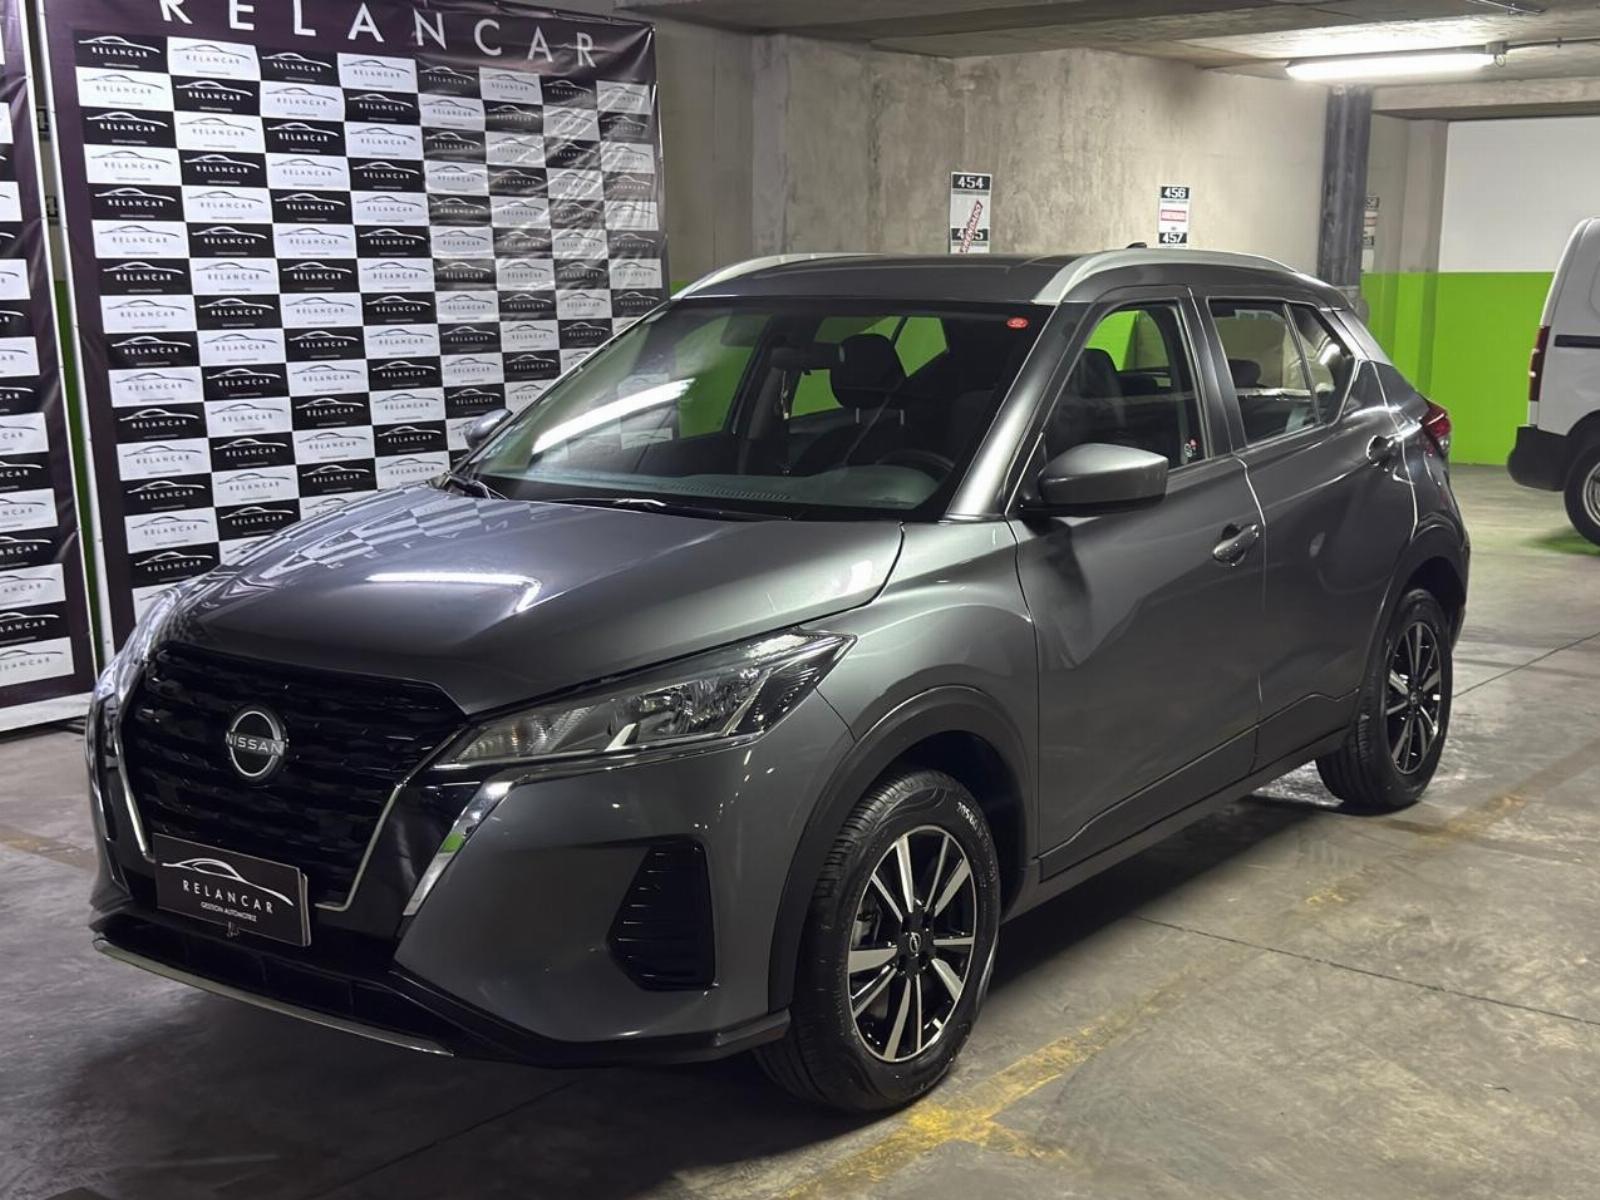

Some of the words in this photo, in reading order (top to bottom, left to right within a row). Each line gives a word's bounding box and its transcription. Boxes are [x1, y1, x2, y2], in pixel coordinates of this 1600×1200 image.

[92, 47, 147, 58] RELANCAR
[186, 54, 240, 65] RELANCAR
[273, 62, 321, 72] RELANCAR
[353, 70, 400, 78] RELANCAR
[96, 85, 152, 95] RELANCAR
[188, 92, 241, 101] RELANCAR
[277, 98, 326, 106] RELANCAR
[100, 123, 155, 132] RELANCAR
[192, 128, 245, 136] RELANCAR
[104, 161, 160, 170] RELANCAR
[196, 165, 248, 174] RELANCAR
[958, 176, 984, 188] 454
[1164, 187, 1186, 198] 456
[108, 199, 163, 207] RELANCAR
[956, 229, 984, 240] 45
[1162, 233, 1183, 243] 457
[128, 382, 182, 391] RELANCAR
[306, 407, 354, 416] RELANCAR
[222, 413, 273, 422] RELANCAR
[131, 418, 186, 428] RELANCAR
[387, 434, 432, 443] RELANCAR
[309, 440, 357, 449] RELANCAR
[226, 447, 276, 456] RELANCAR
[136, 454, 190, 464] RELANCAR
[390, 466, 435, 475] RELANCAR
[312, 473, 359, 483] RELANCAR
[229, 481, 279, 491] RELANCAR
[140, 489, 193, 500] RELANCAR
[232, 514, 282, 525] RELANCAR
[144, 524, 198, 536] RELANCAR
[147, 559, 201, 572] RELANCAR
[226, 732, 284, 756] NISSAN
[182, 880, 273, 914] RELANCAR
